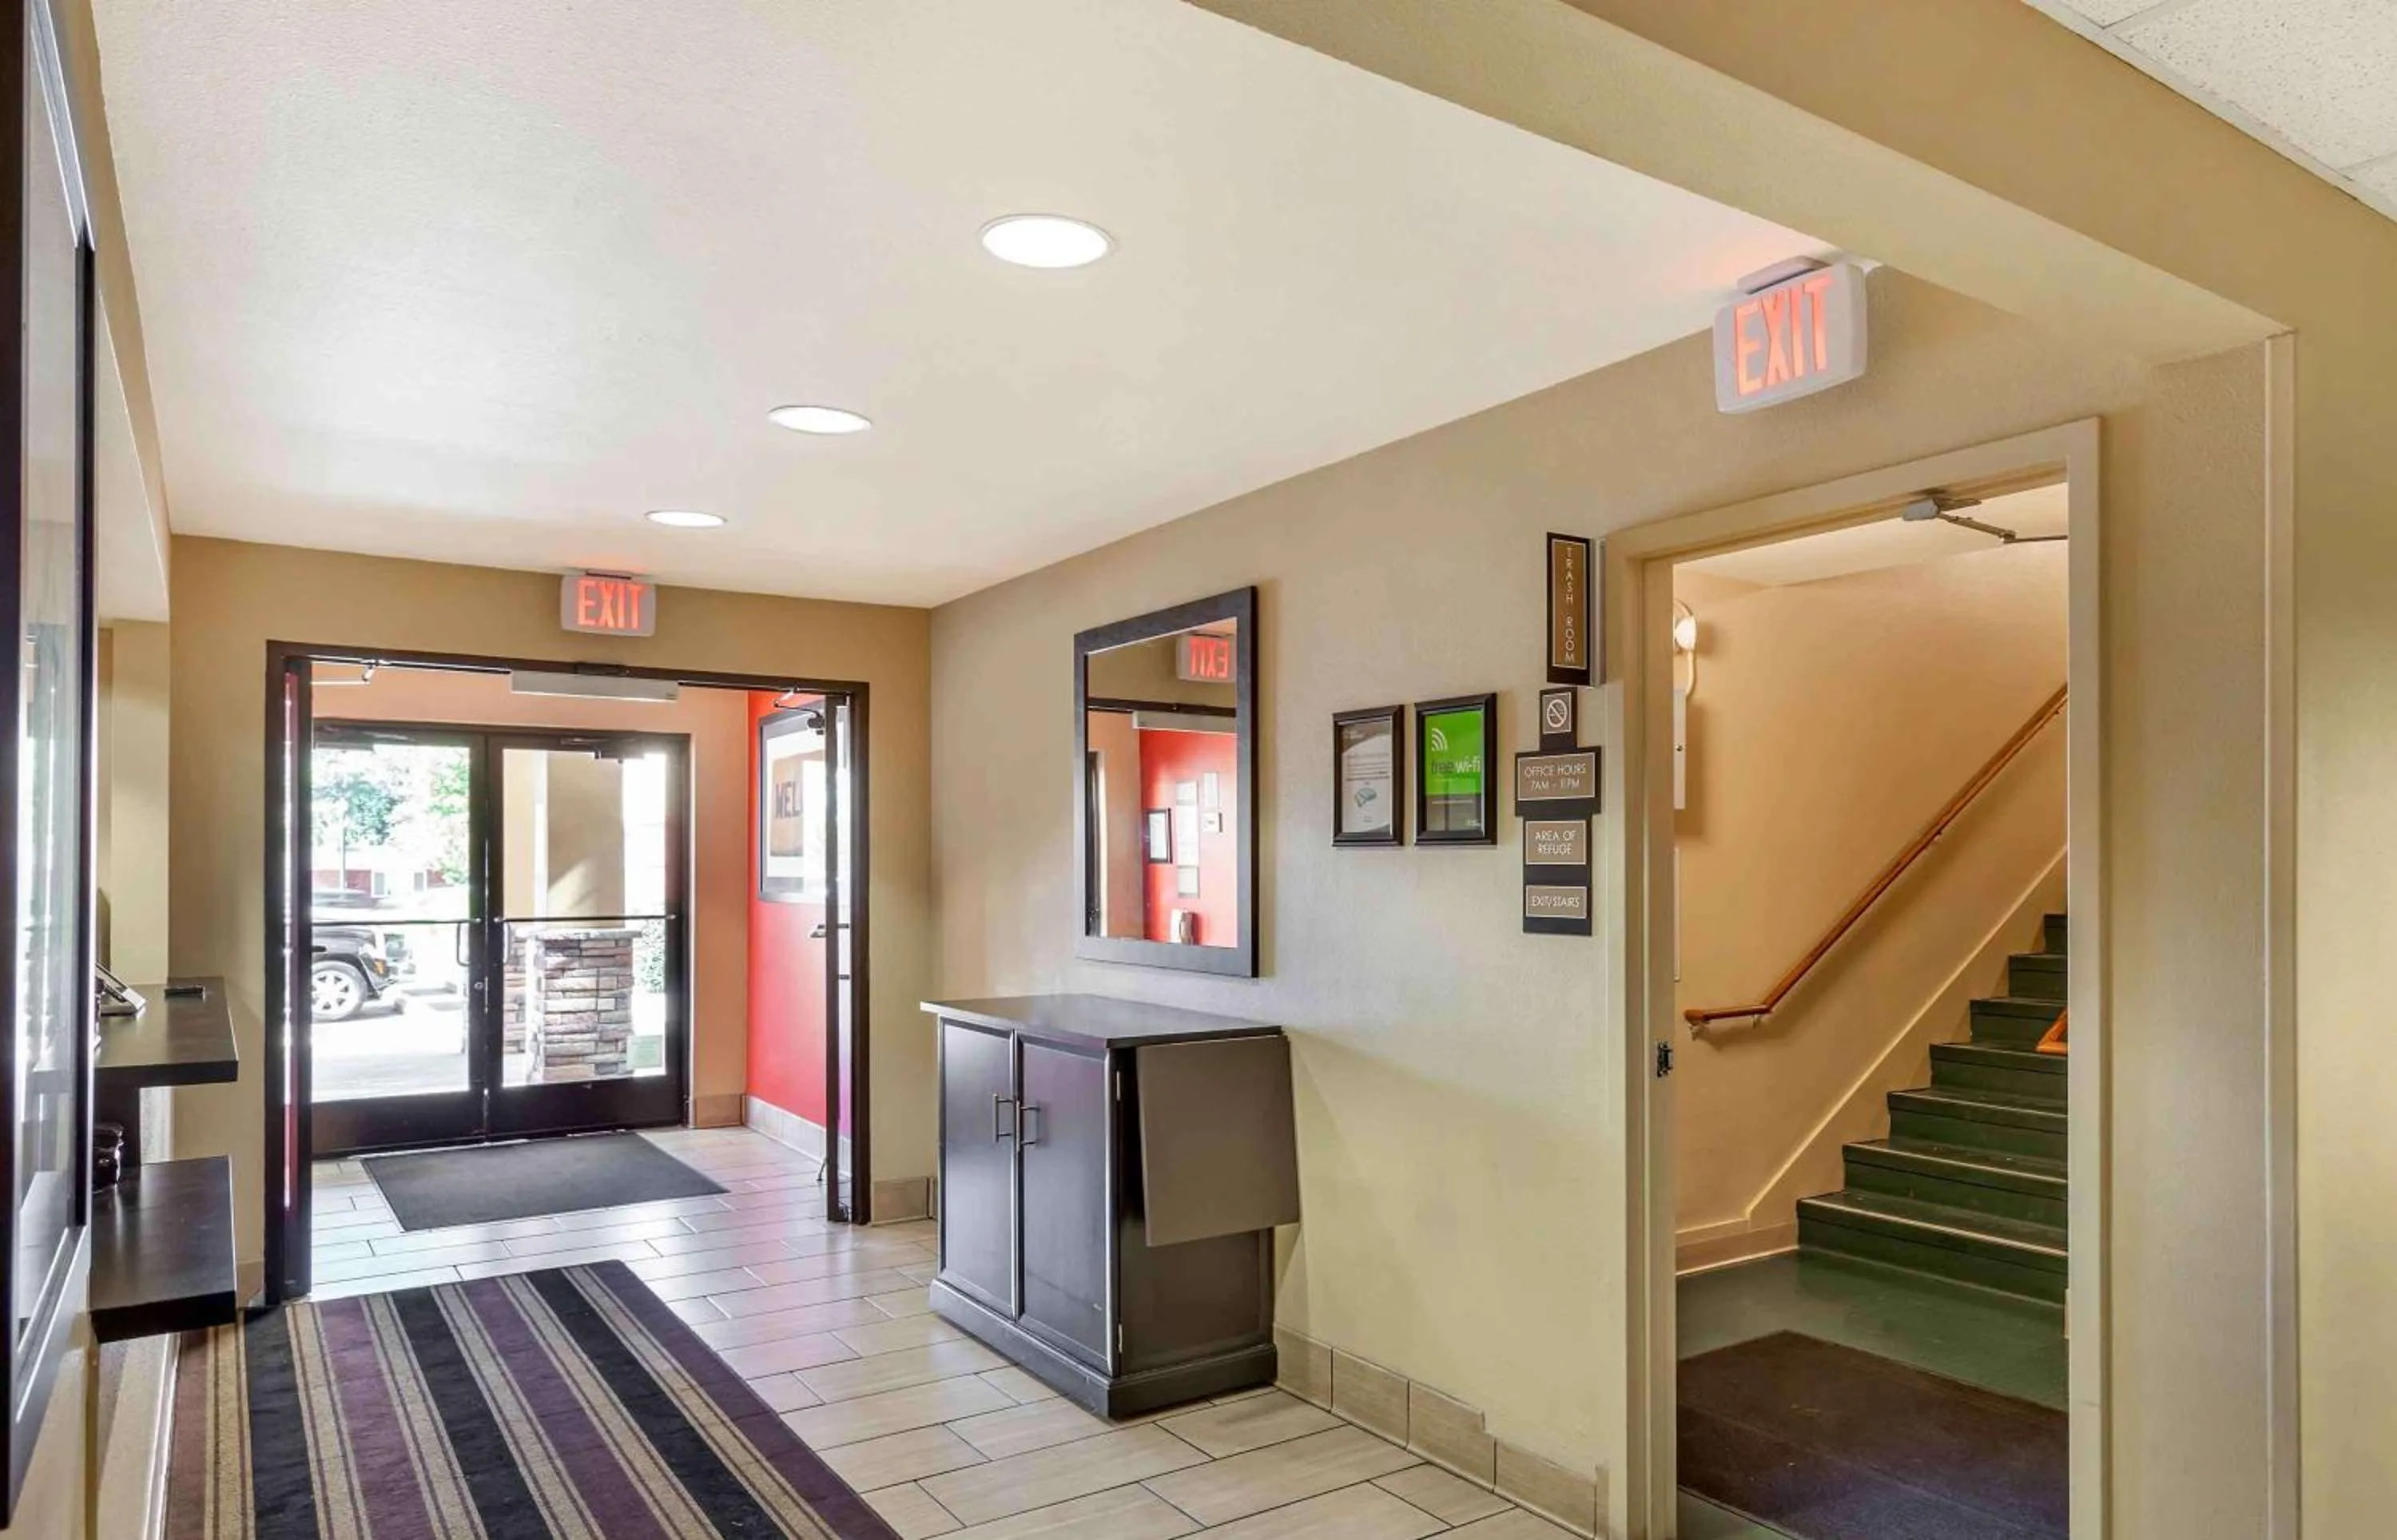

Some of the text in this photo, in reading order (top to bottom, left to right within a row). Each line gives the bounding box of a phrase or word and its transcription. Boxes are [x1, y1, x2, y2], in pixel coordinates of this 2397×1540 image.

[1734, 272, 1832, 397] EXIT
[578, 578, 643, 629] EXIT
[1564, 547, 1575, 663] TRASH ROOM
[1524, 763, 1586, 777] OFFICE HOURS
[1531, 780, 1550, 792] 7AM
[1535, 830, 1576, 841] AREA OF
[1536, 843, 1572, 855] REFUGE
[1531, 895, 1581, 908] EXIT/STAIRS
